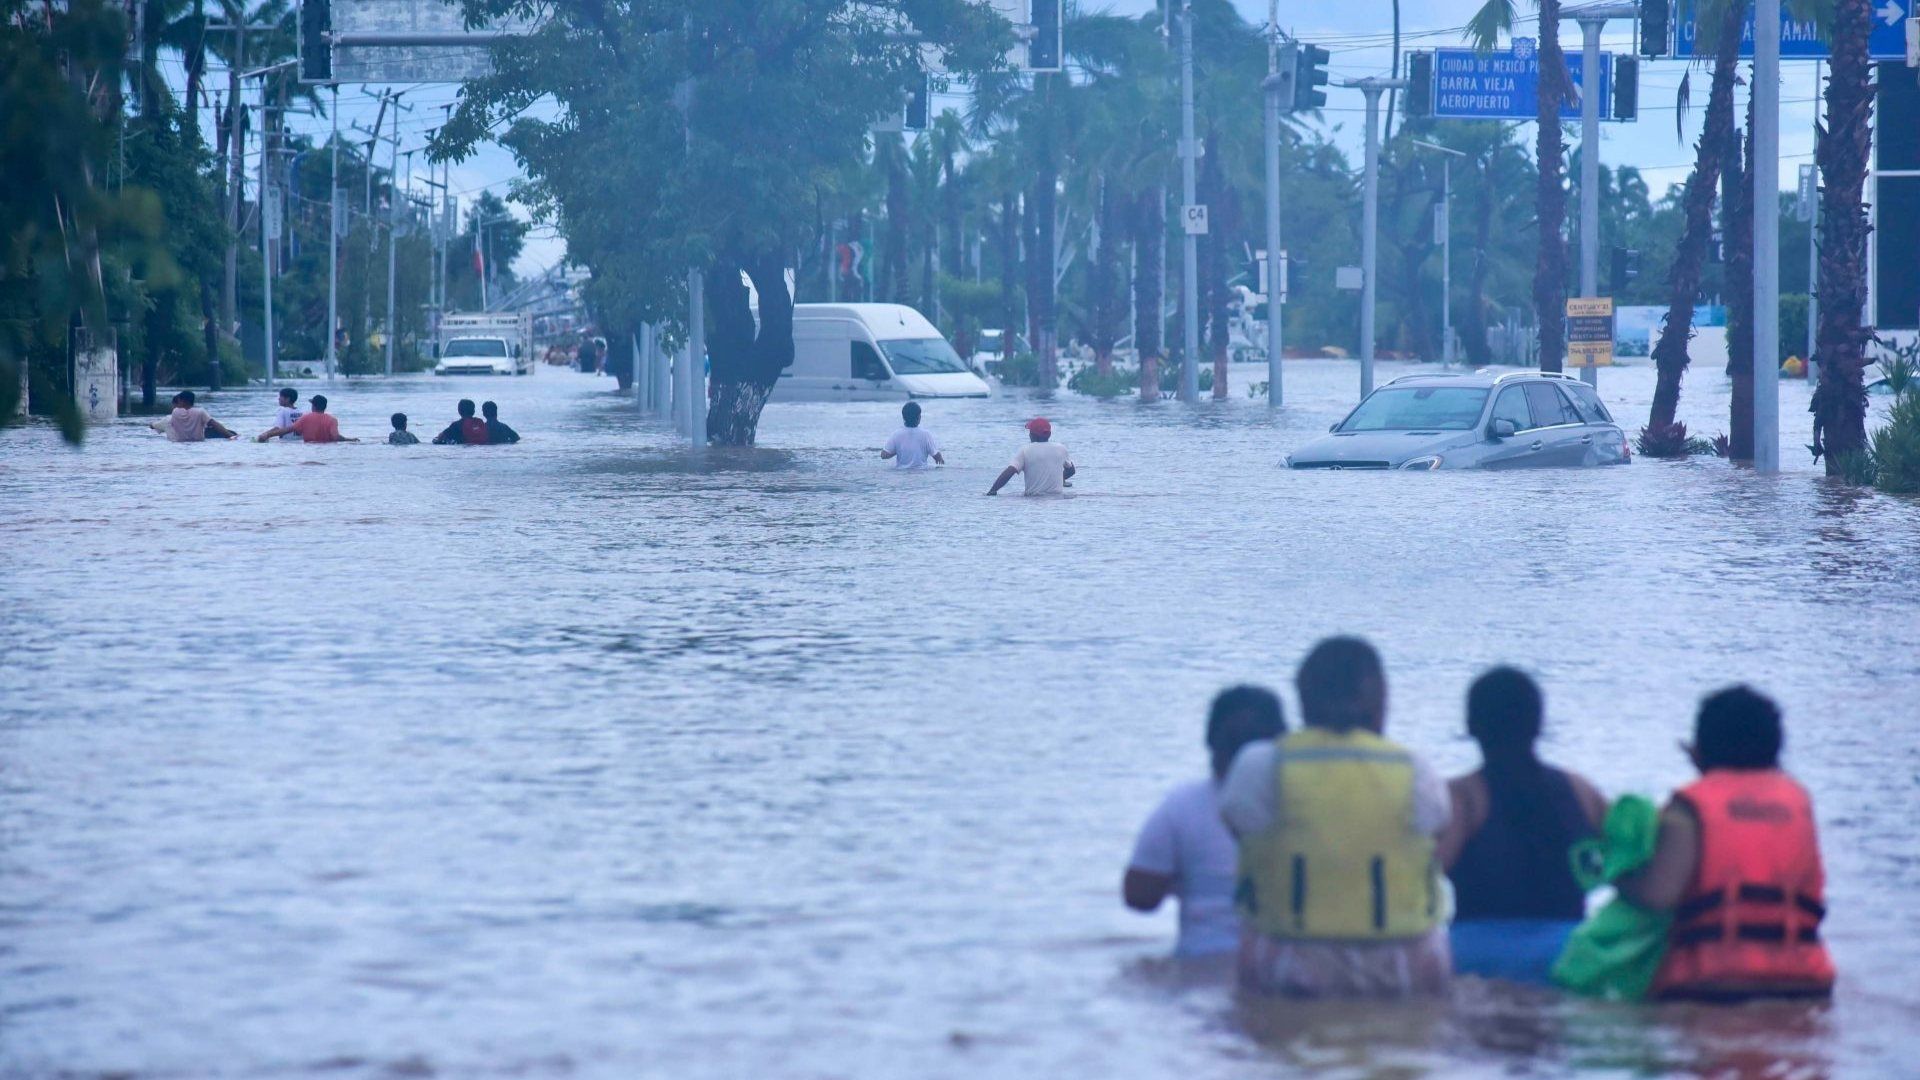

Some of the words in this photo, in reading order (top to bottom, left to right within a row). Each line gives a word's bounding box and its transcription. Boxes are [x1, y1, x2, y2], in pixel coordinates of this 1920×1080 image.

[1441, 58, 1474, 72] CIUDAD
[1478, 59, 1489, 72] DE
[1493, 60, 1526, 73] MEXICO
[1441, 77, 1477, 91] BARRA
[1484, 78, 1515, 92] VIEJA
[1441, 95, 1510, 109] AEROPUERTO
[1188, 208, 1204, 220] C4
